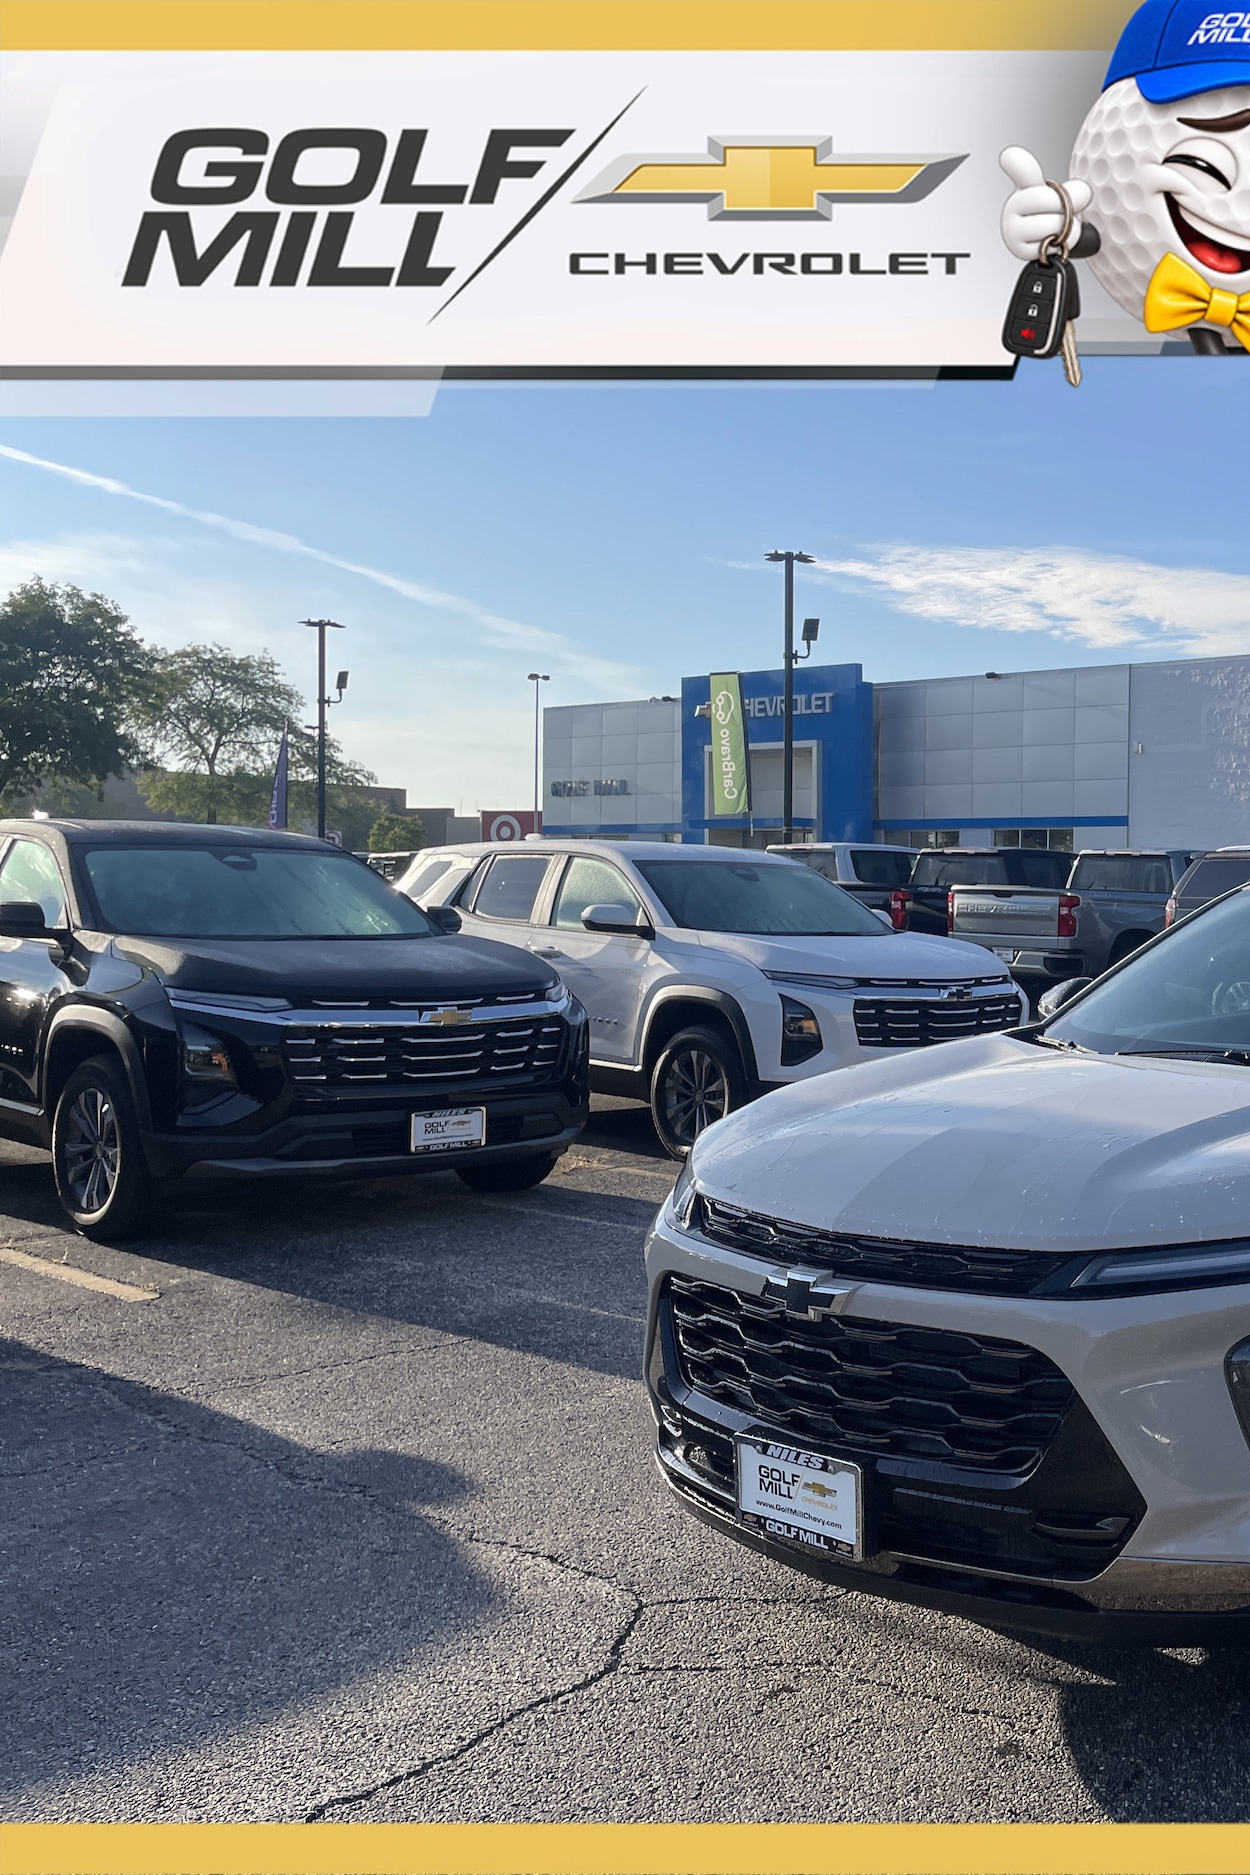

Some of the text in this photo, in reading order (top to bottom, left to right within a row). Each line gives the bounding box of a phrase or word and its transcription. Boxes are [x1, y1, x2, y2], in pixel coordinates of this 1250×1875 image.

[744, 691, 834, 718] HEVROLET
[424, 1120, 450, 1128] GOLF
[766, 1444, 824, 1470] NILES
[758, 1464, 801, 1487] GOLF
[759, 1477, 794, 1500] MILL
[755, 1499, 843, 1530] www.GolfMillChevy.com
[765, 1519, 829, 1550] GOLF MILL
